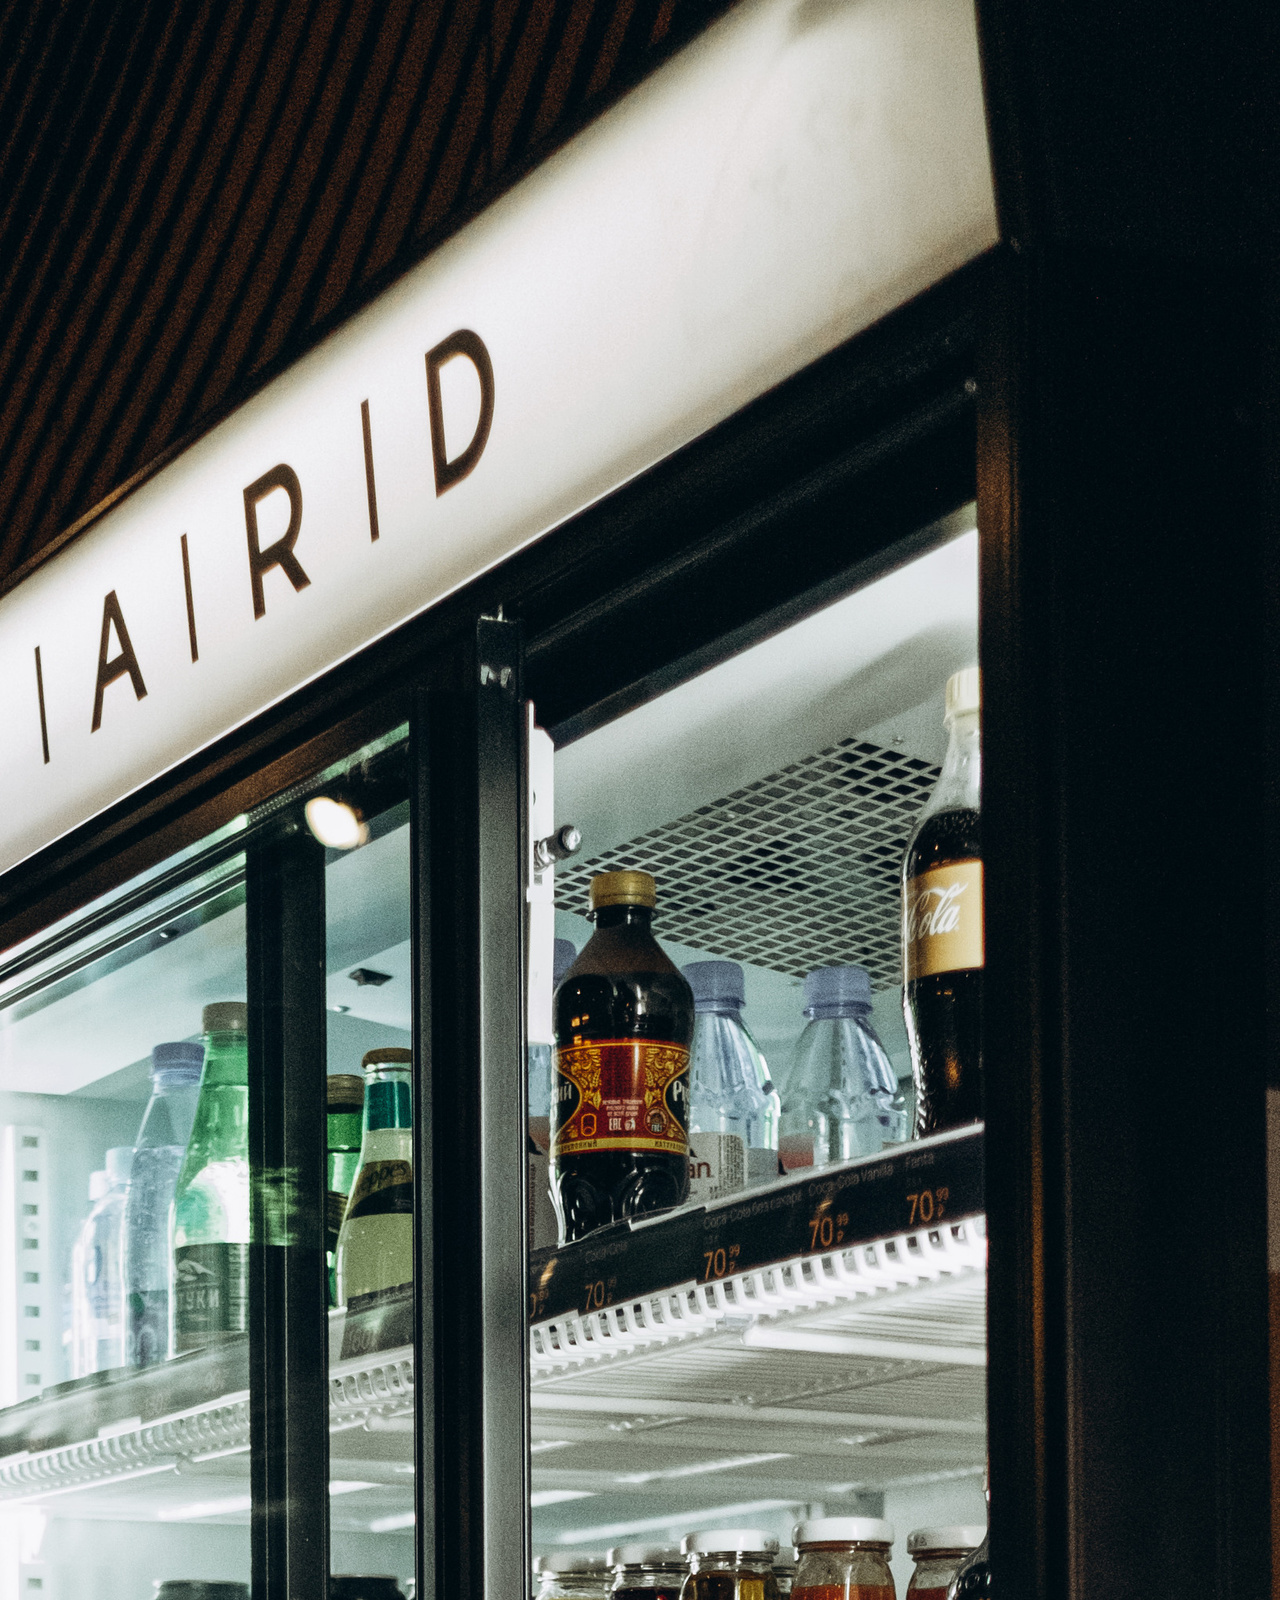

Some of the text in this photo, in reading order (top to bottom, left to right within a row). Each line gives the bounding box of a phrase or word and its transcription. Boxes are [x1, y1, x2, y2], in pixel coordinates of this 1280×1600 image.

[906, 1190, 934, 1225] 70
[808, 1217, 833, 1249] 70
[704, 1248, 727, 1280] 70
[585, 1281, 605, 1311] 70
